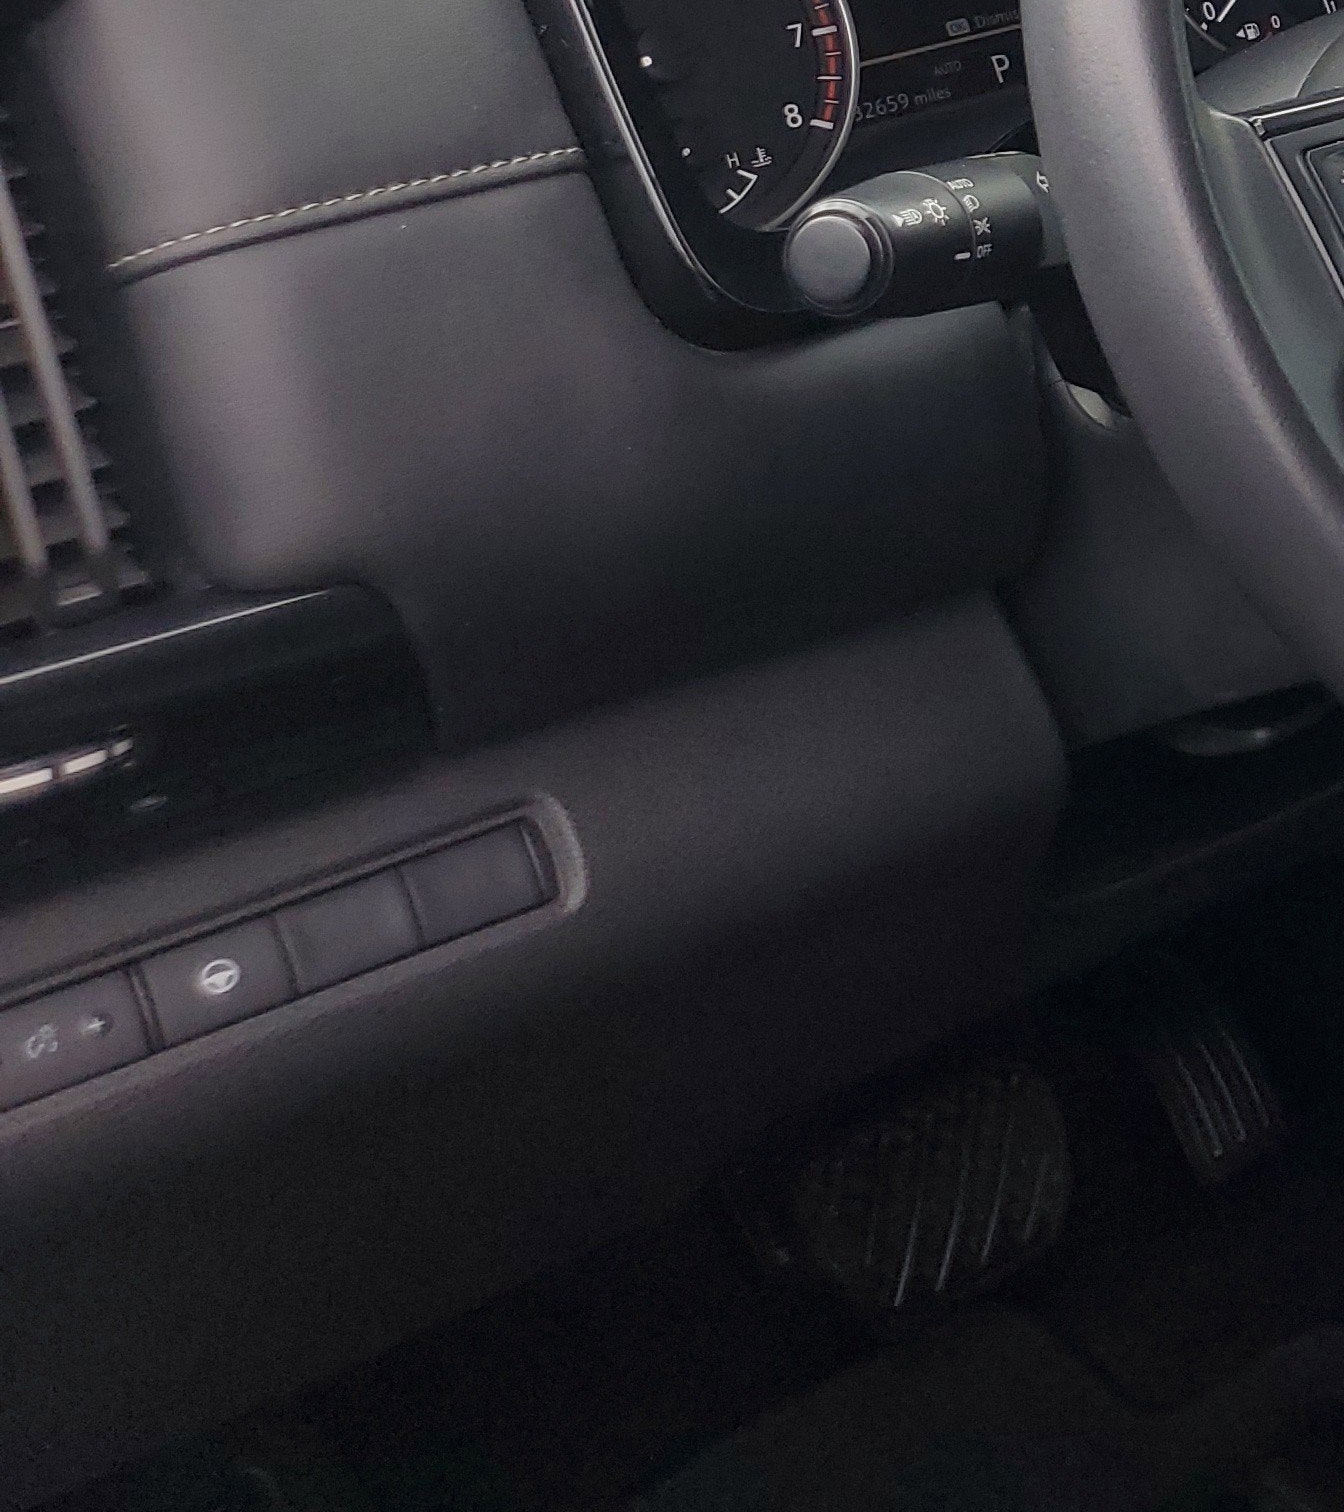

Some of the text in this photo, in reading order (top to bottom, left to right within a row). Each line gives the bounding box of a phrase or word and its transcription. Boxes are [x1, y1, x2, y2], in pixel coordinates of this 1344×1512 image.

[1202, 1, 1216, 21] 0
[1270, 15, 1281, 29] 0
[785, 22, 803, 48] 7
[990, 54, 1010, 84] P
[913, 87, 952, 106] miles
[783, 103, 803, 129] 8
[726, 152, 740, 170] H
[976, 243, 993, 259] OFF
